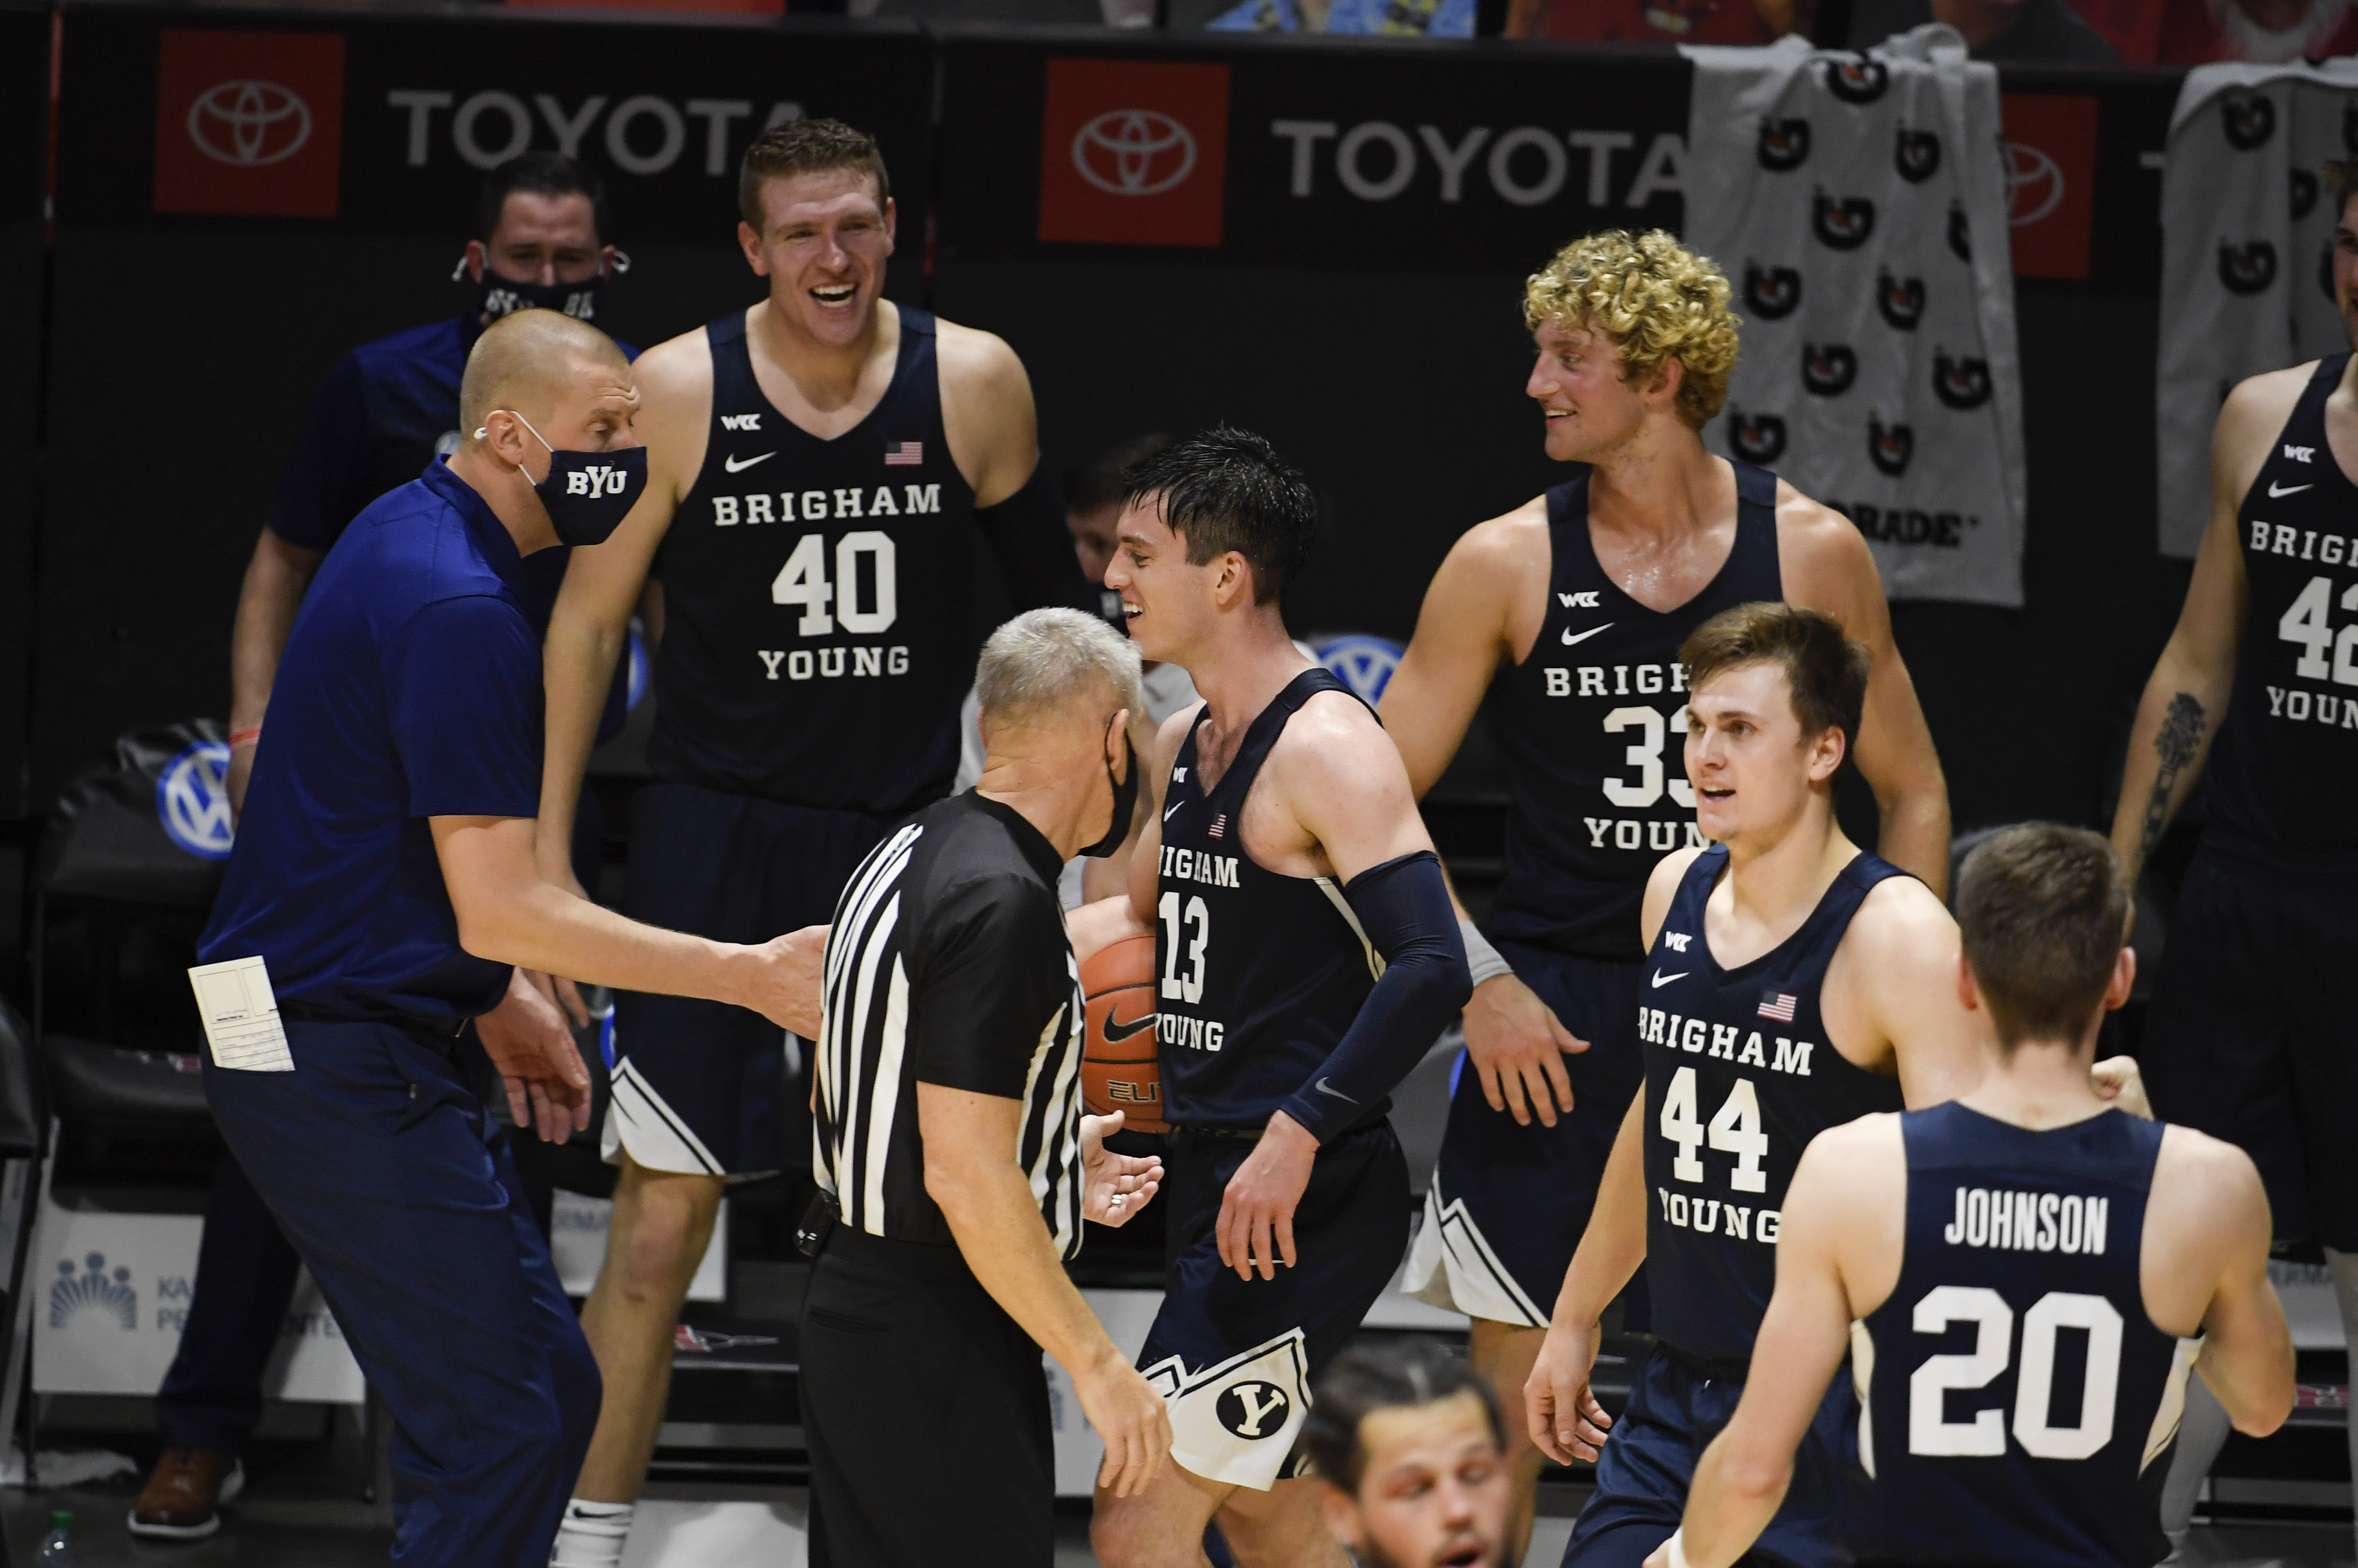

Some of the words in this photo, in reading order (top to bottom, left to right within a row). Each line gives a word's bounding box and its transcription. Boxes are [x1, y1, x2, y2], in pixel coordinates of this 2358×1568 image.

[387, 90, 806, 177] TOYOT
[566, 465, 628, 499] BYU
[712, 483, 942, 526] BRIGHAM
[772, 530, 897, 637] 40
[758, 646, 909, 680] YOUNG
[1159, 891, 1209, 1004] 13
[1638, 1007, 1814, 1076] BRIGHAM
[1107, 1079, 1160, 1102] ELI
[1660, 1066, 1768, 1193] 44
[1658, 1186, 1781, 1244] YOUNG
[1945, 1187, 2108, 1255] JOHNSON
[1908, 1285, 2125, 1460] 20
